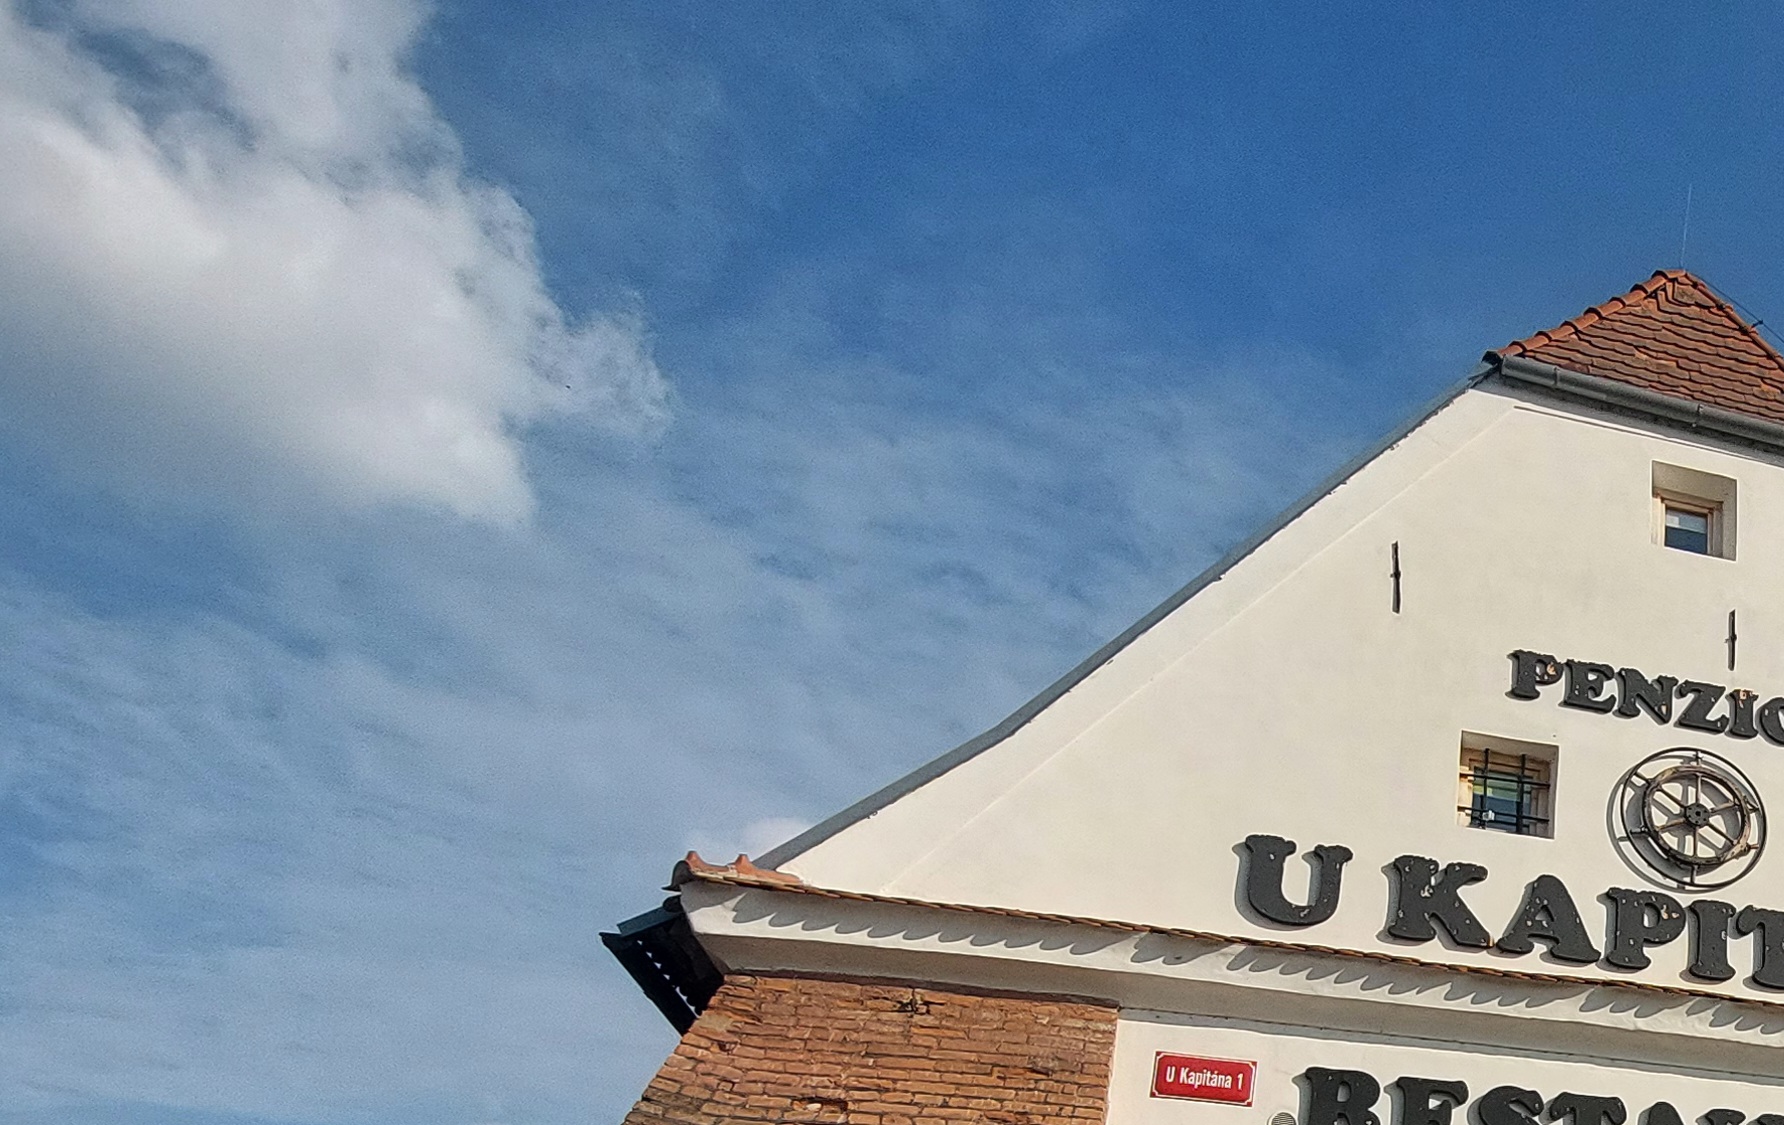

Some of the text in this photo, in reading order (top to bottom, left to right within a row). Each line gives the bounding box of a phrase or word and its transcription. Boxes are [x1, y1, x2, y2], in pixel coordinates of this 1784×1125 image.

[1242, 834, 1354, 926] U
[1165, 1065, 1244, 1090] U Kapitána 1
